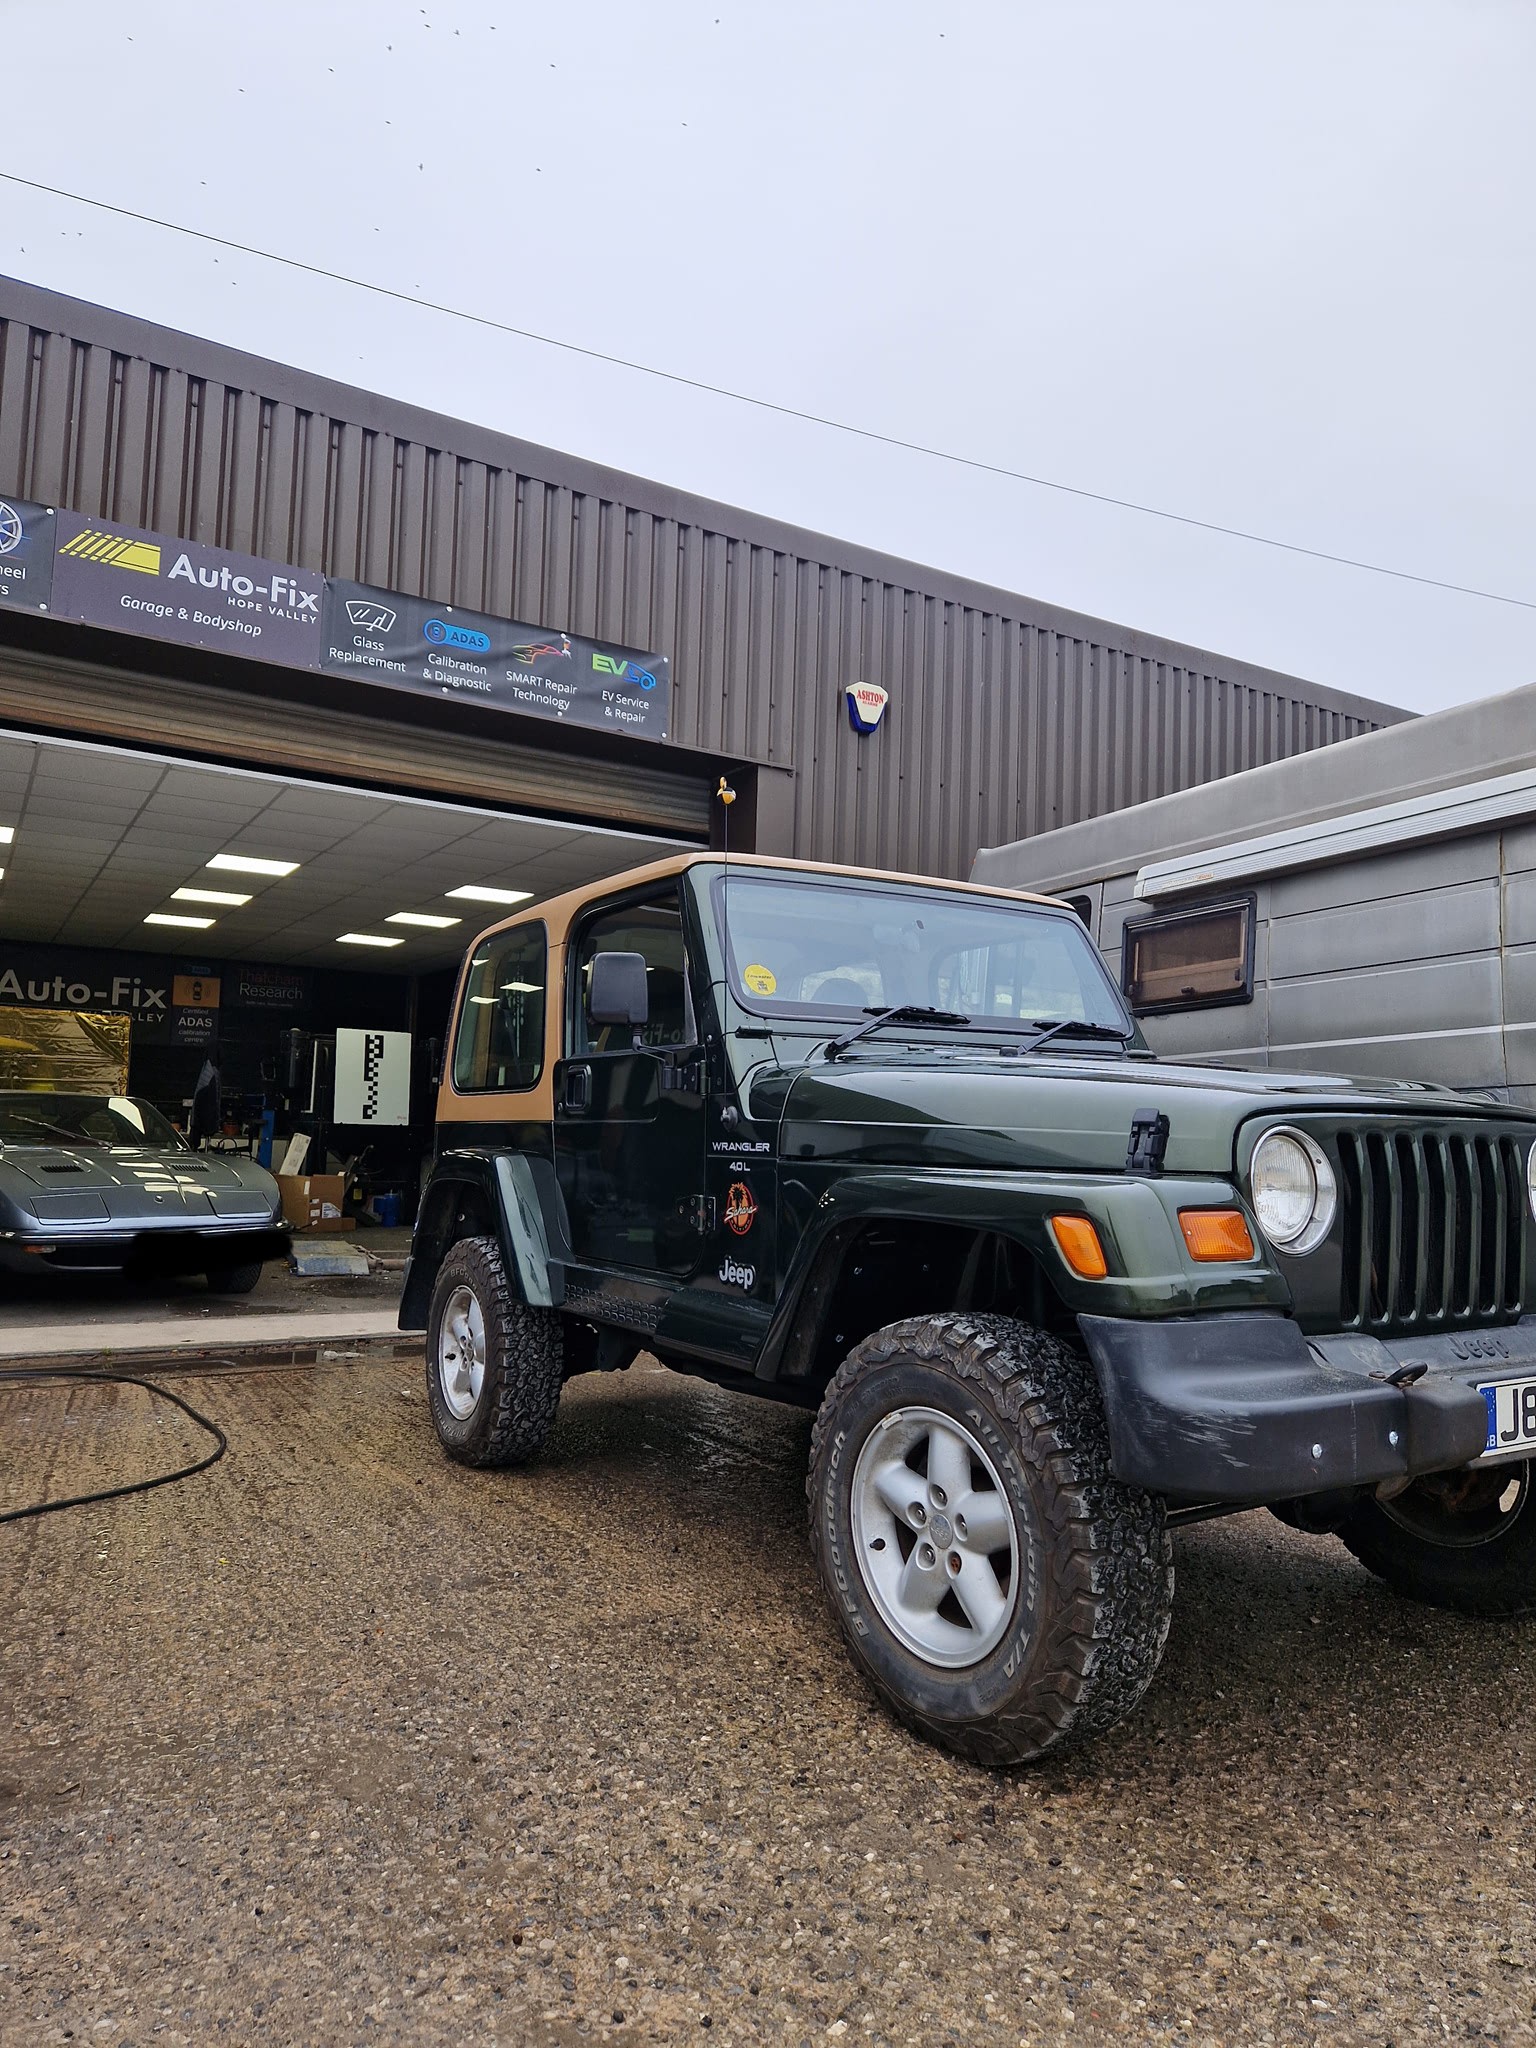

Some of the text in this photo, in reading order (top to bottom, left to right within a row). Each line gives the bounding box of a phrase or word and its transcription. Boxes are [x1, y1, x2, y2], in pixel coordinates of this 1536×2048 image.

[167, 553, 319, 612] Auto-Fix
[120, 594, 262, 637] Garage & Bodyshop
[227, 596, 317, 624] HOPE VALLEY
[353, 635, 385, 651] Glass
[450, 632, 485, 647] ADAS
[329, 647, 406, 672] Replacement
[427, 653, 487, 675] Calibration
[592, 653, 628, 675] EV
[422, 668, 492, 692] & Diagnostic
[506, 670, 578, 695] SMART Repair
[512, 687, 571, 711] Technology
[602, 690, 650, 710] EV Service
[857, 689, 884, 704] ASHTON
[604, 706, 646, 724] & Repair
[0, 968, 167, 1009] Auto-Fix
[239, 982, 303, 999] Research
[178, 1017, 213, 1028] ADAS
[178, 1028, 211, 1037] calibration
[712, 1142, 771, 1153] WRANGLER
[719, 1259, 753, 1289] Jeep
[1448, 1335, 1510, 1361] Jeep
[826, 1430, 869, 1637] BFGoodrich
[1003, 1630, 1030, 1679] T/A
